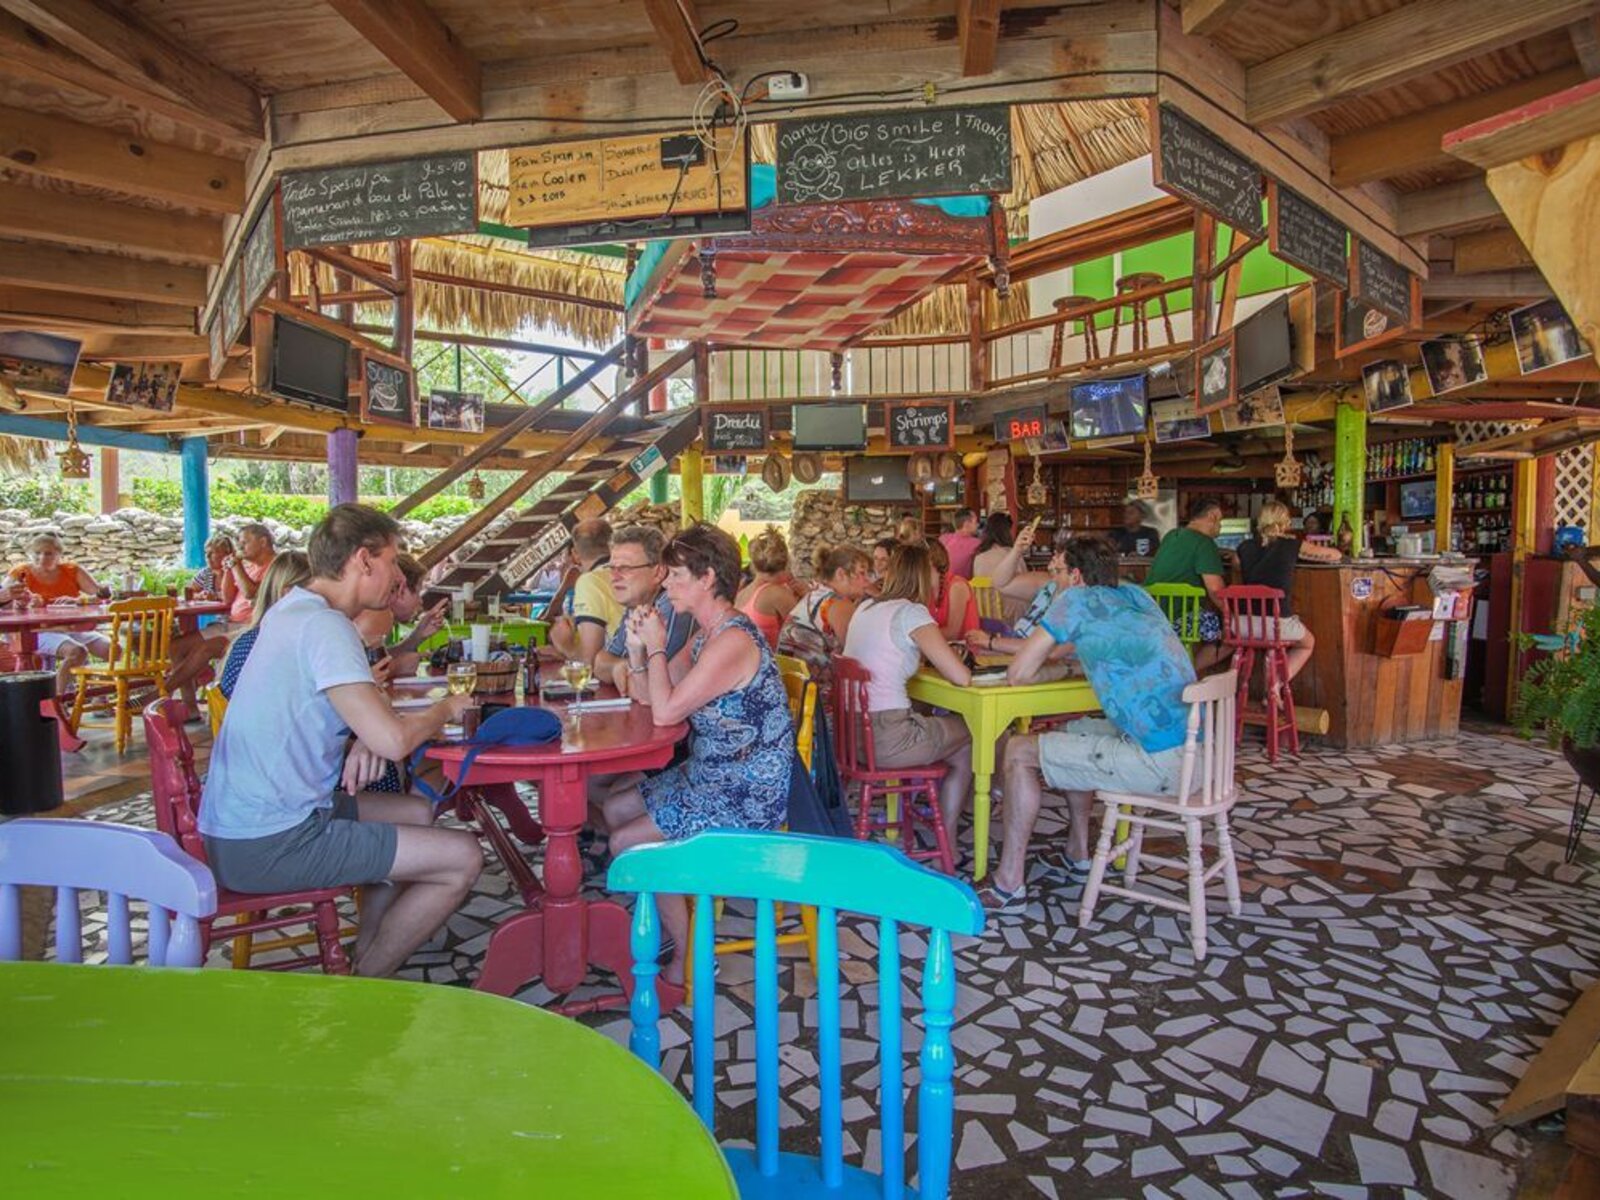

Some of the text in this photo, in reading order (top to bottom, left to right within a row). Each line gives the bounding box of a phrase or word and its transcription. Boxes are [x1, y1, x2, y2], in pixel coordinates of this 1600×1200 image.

[860, 159, 963, 191] LEKKER
[714, 413, 762, 430] Dradu
[896, 411, 948, 431] Shrimps
[1010, 421, 1041, 439] BAR
